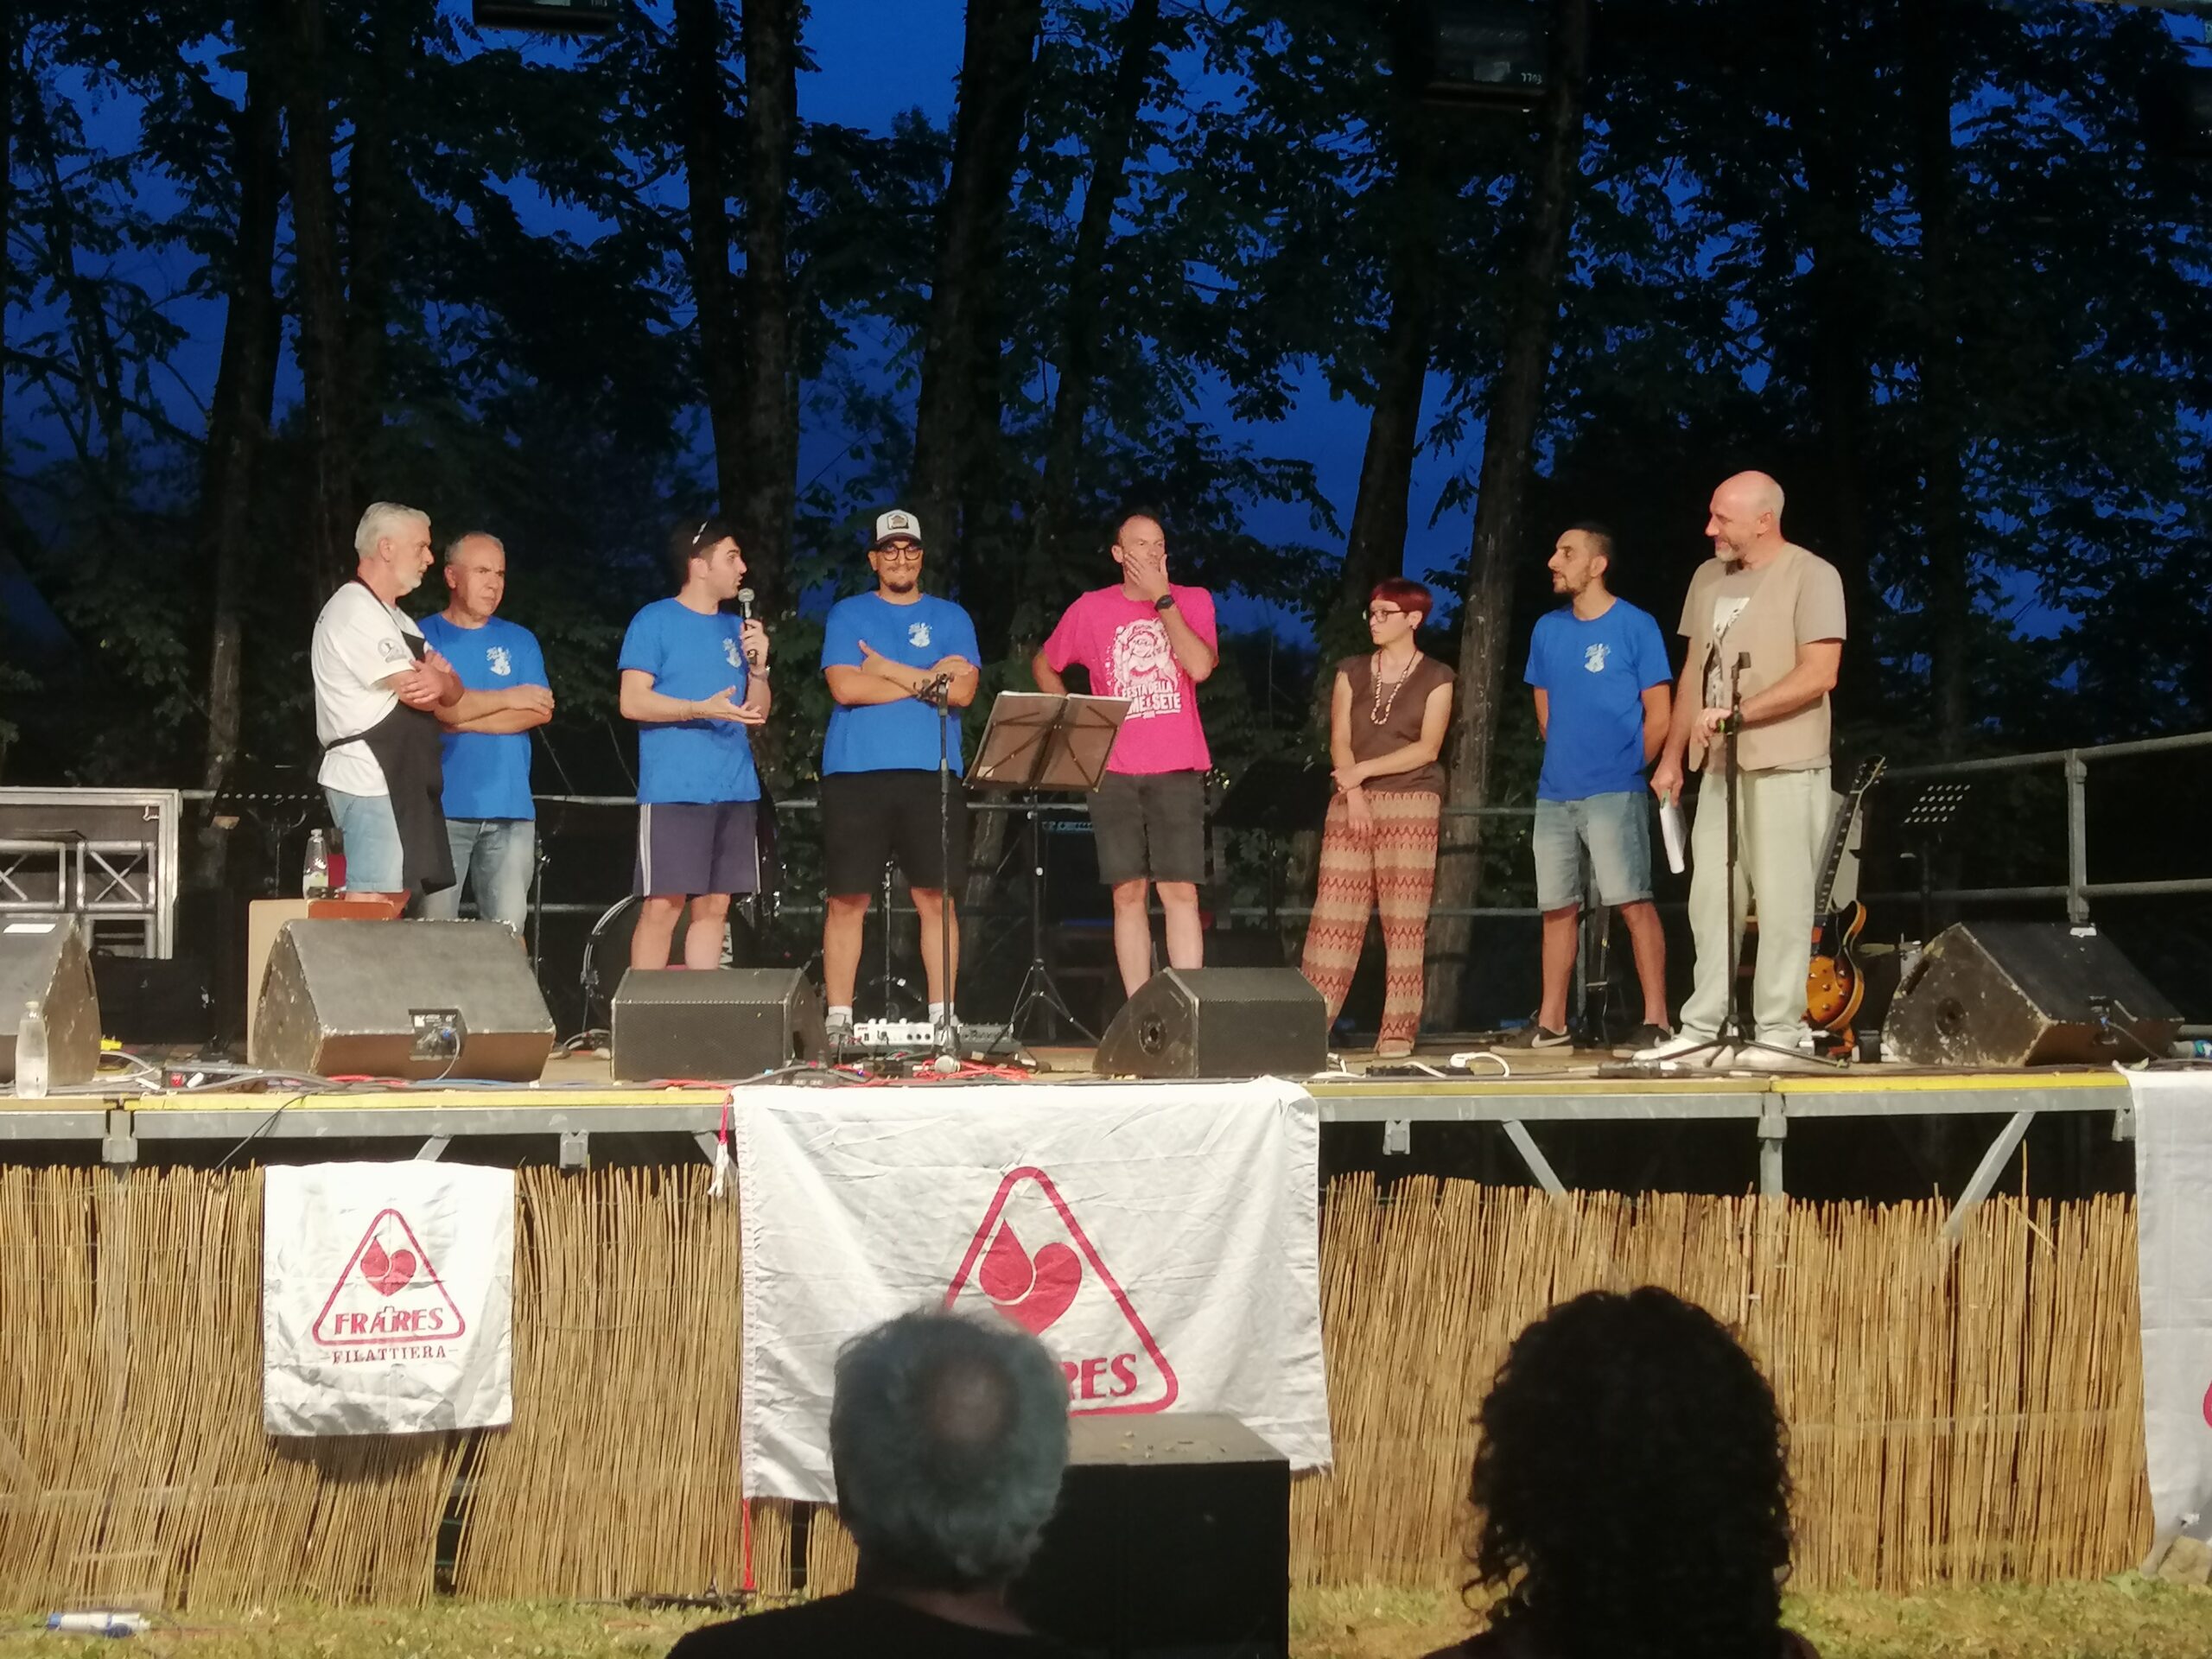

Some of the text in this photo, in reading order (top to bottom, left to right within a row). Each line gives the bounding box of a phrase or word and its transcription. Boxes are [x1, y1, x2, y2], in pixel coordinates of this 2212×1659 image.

[1122, 680, 1173, 698] FESTA DELLA
[332, 1344, 447, 1365] FILATTIERA
